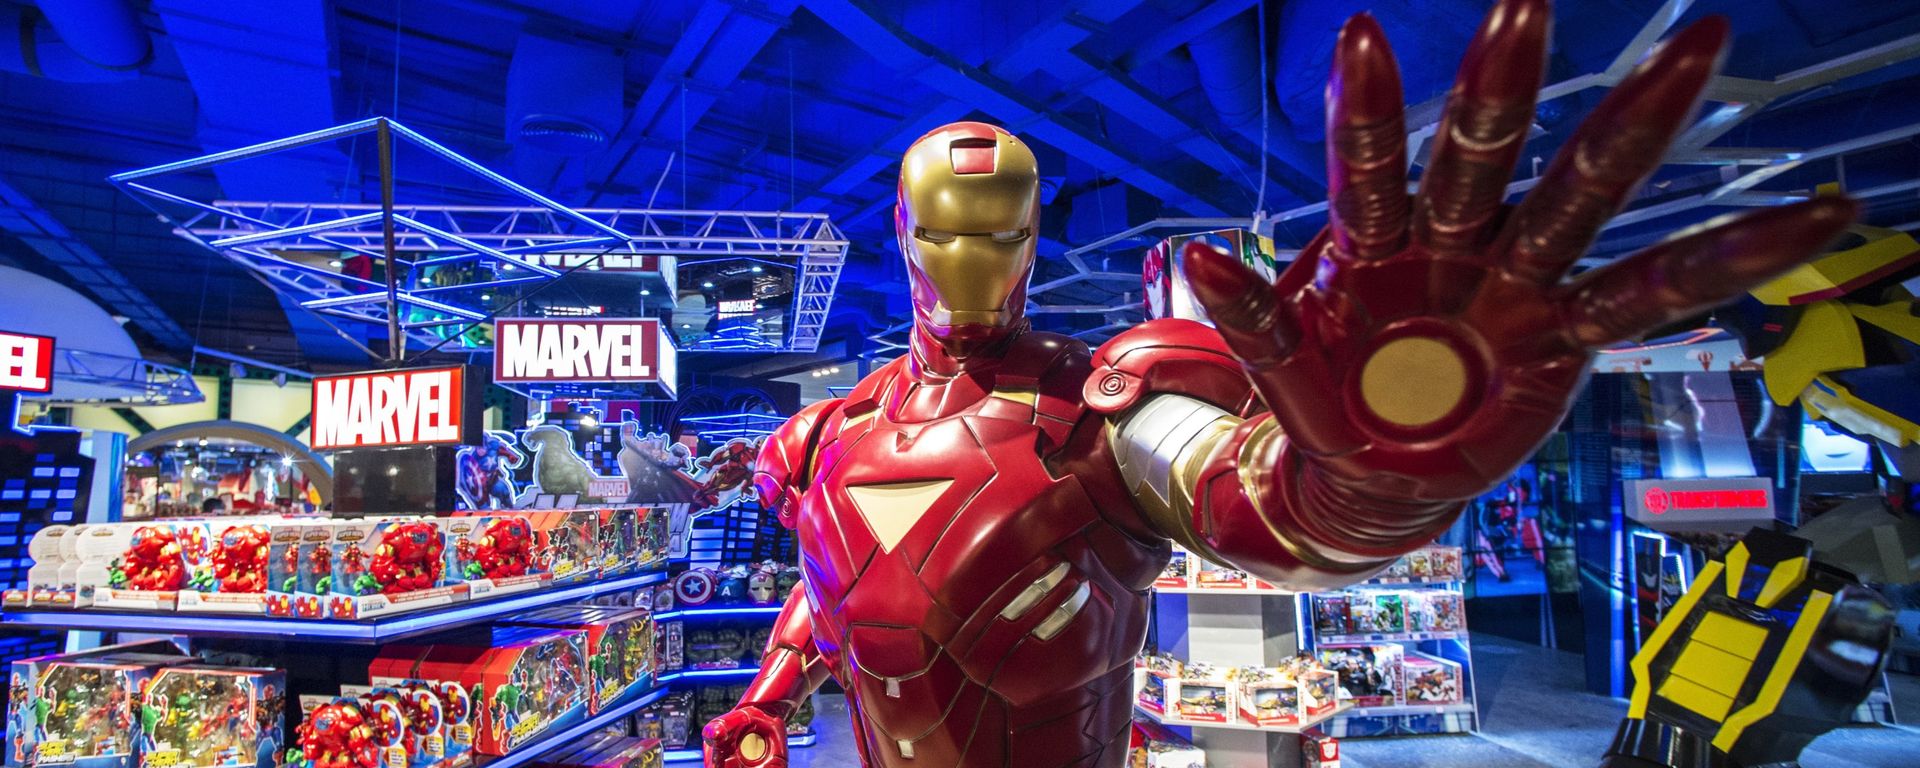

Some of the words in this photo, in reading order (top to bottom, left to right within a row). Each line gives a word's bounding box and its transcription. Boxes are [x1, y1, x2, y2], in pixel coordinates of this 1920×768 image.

[502, 324, 650, 377] MARVEL
[315, 370, 458, 447] MARVEL
[588, 481, 628, 497] MARVEL
[1669, 490, 1768, 510] TRANSFORMERS
[721, 586, 731, 596] A
